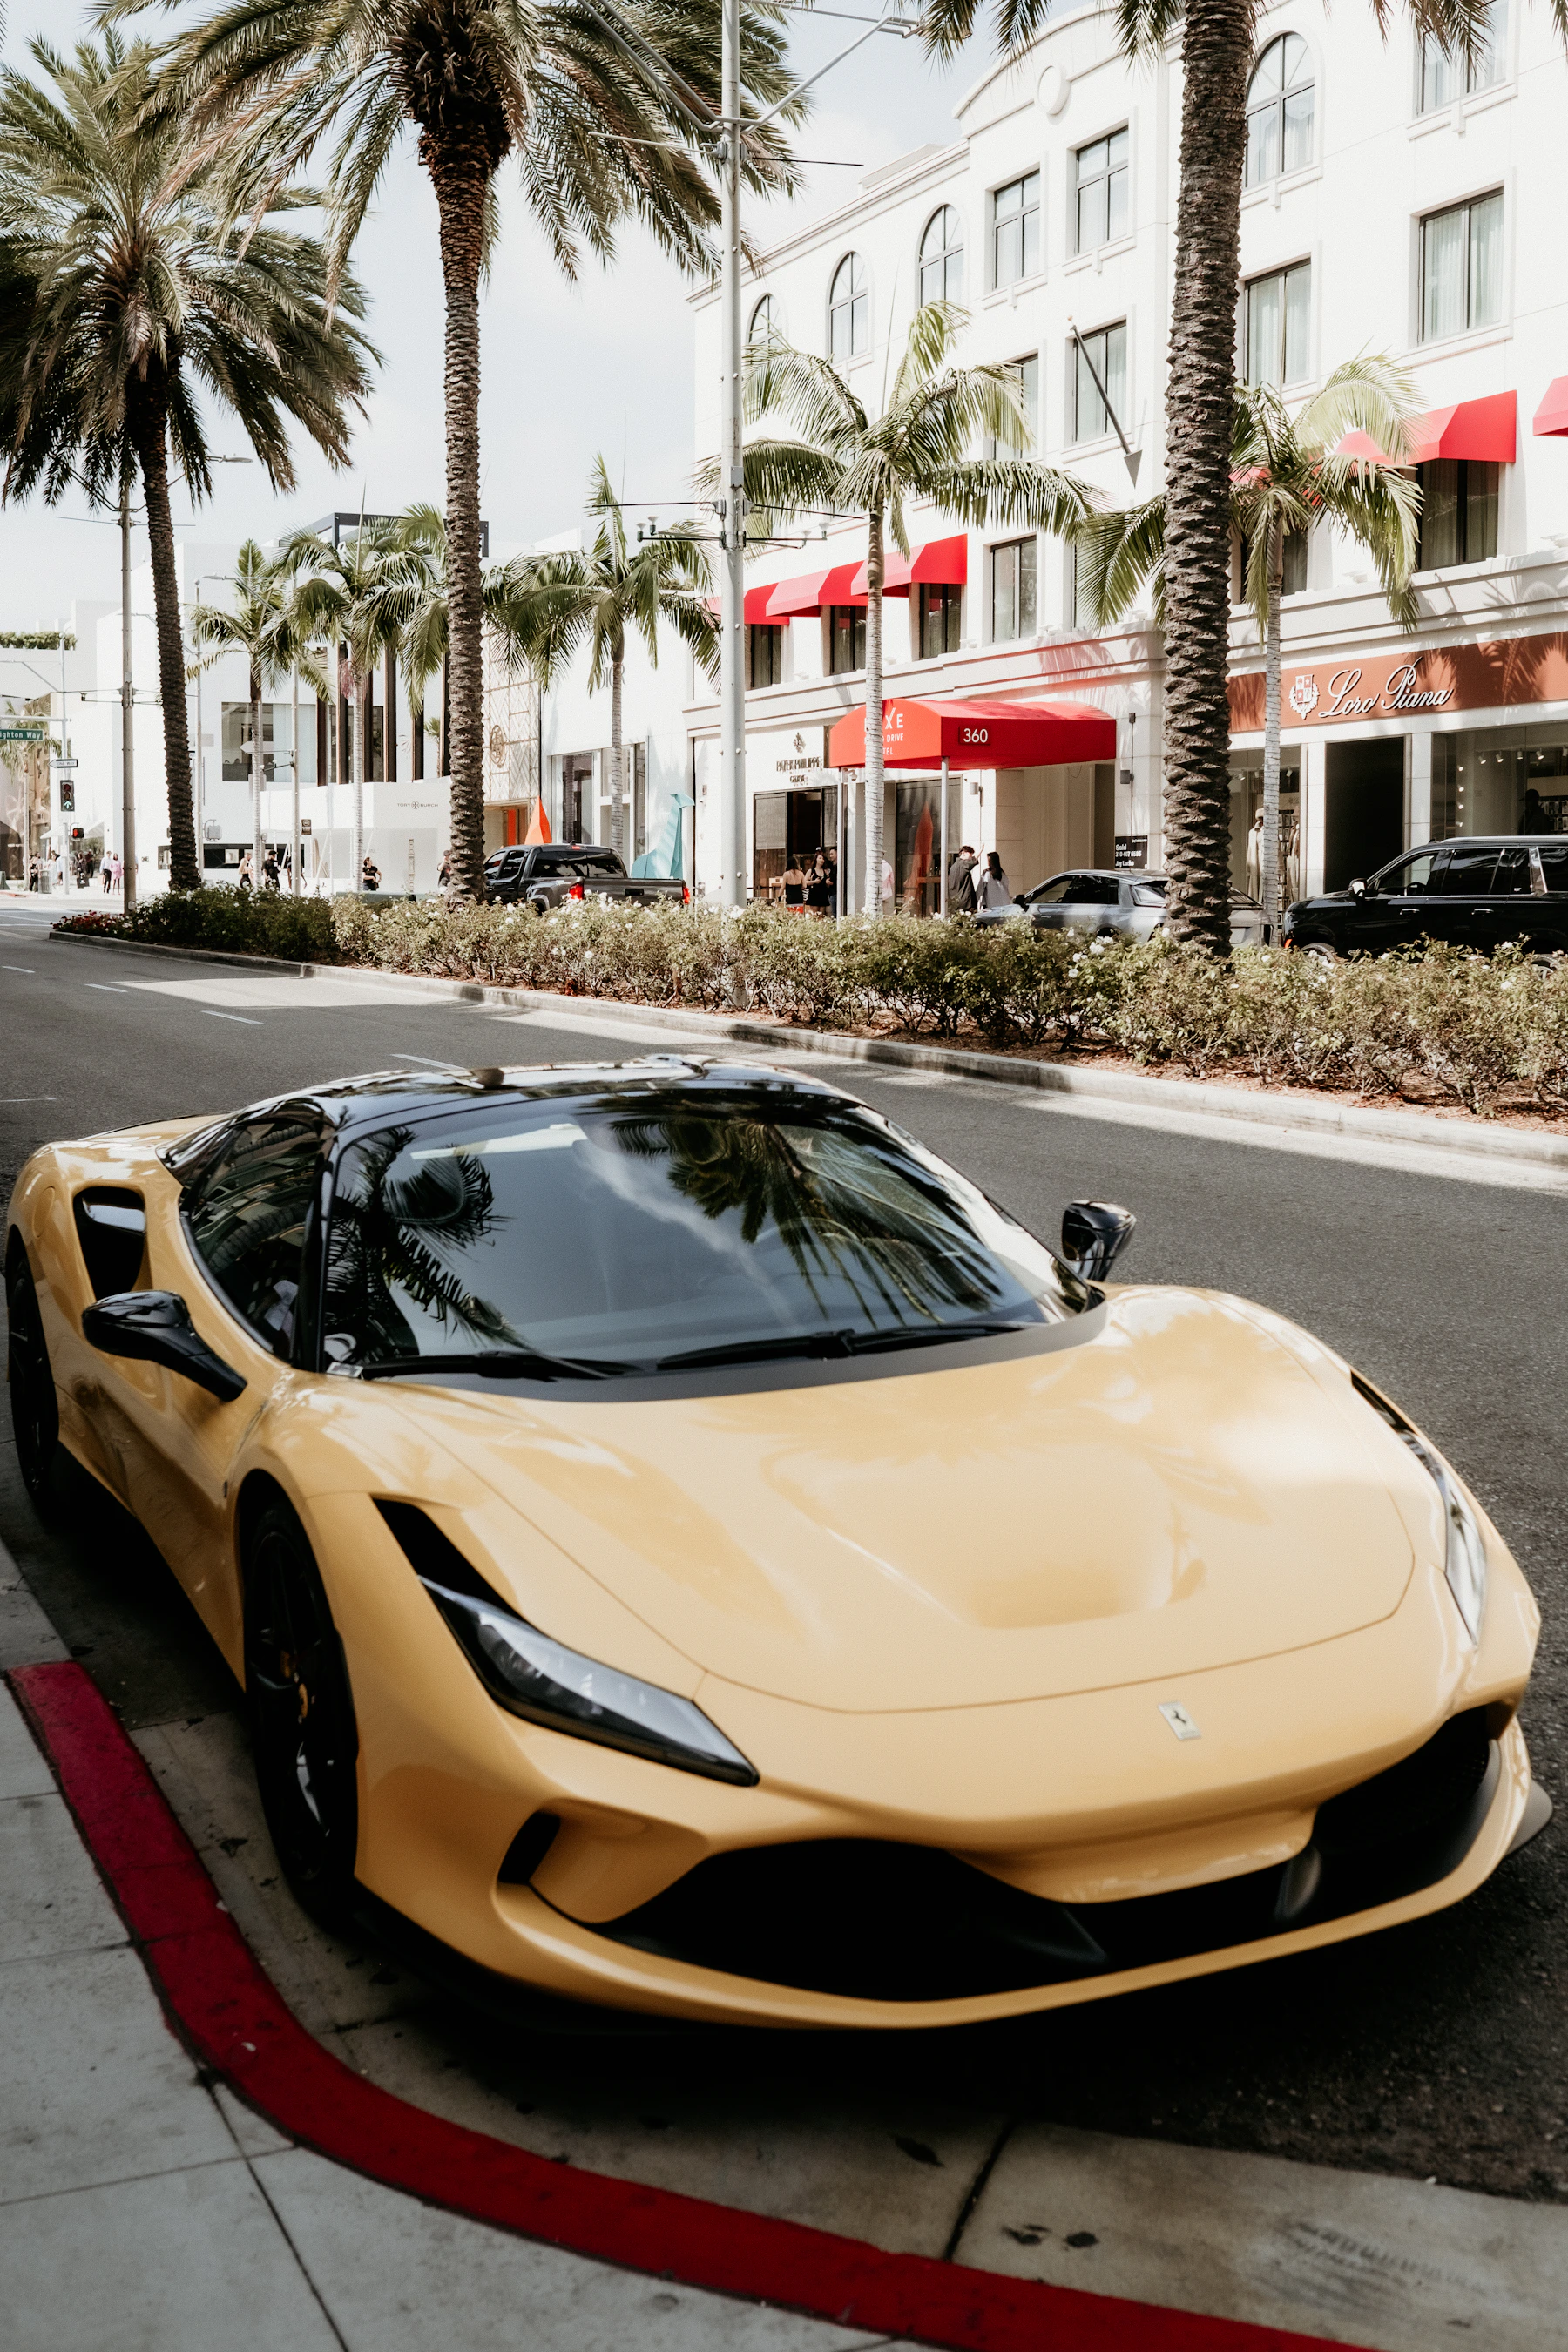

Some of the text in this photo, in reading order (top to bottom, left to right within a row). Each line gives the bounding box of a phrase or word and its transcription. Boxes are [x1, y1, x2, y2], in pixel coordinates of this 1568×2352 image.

[1318, 656, 1454, 718] Loro Piana
[886, 733, 903, 742] DRIVE
[963, 727, 988, 743] 360
